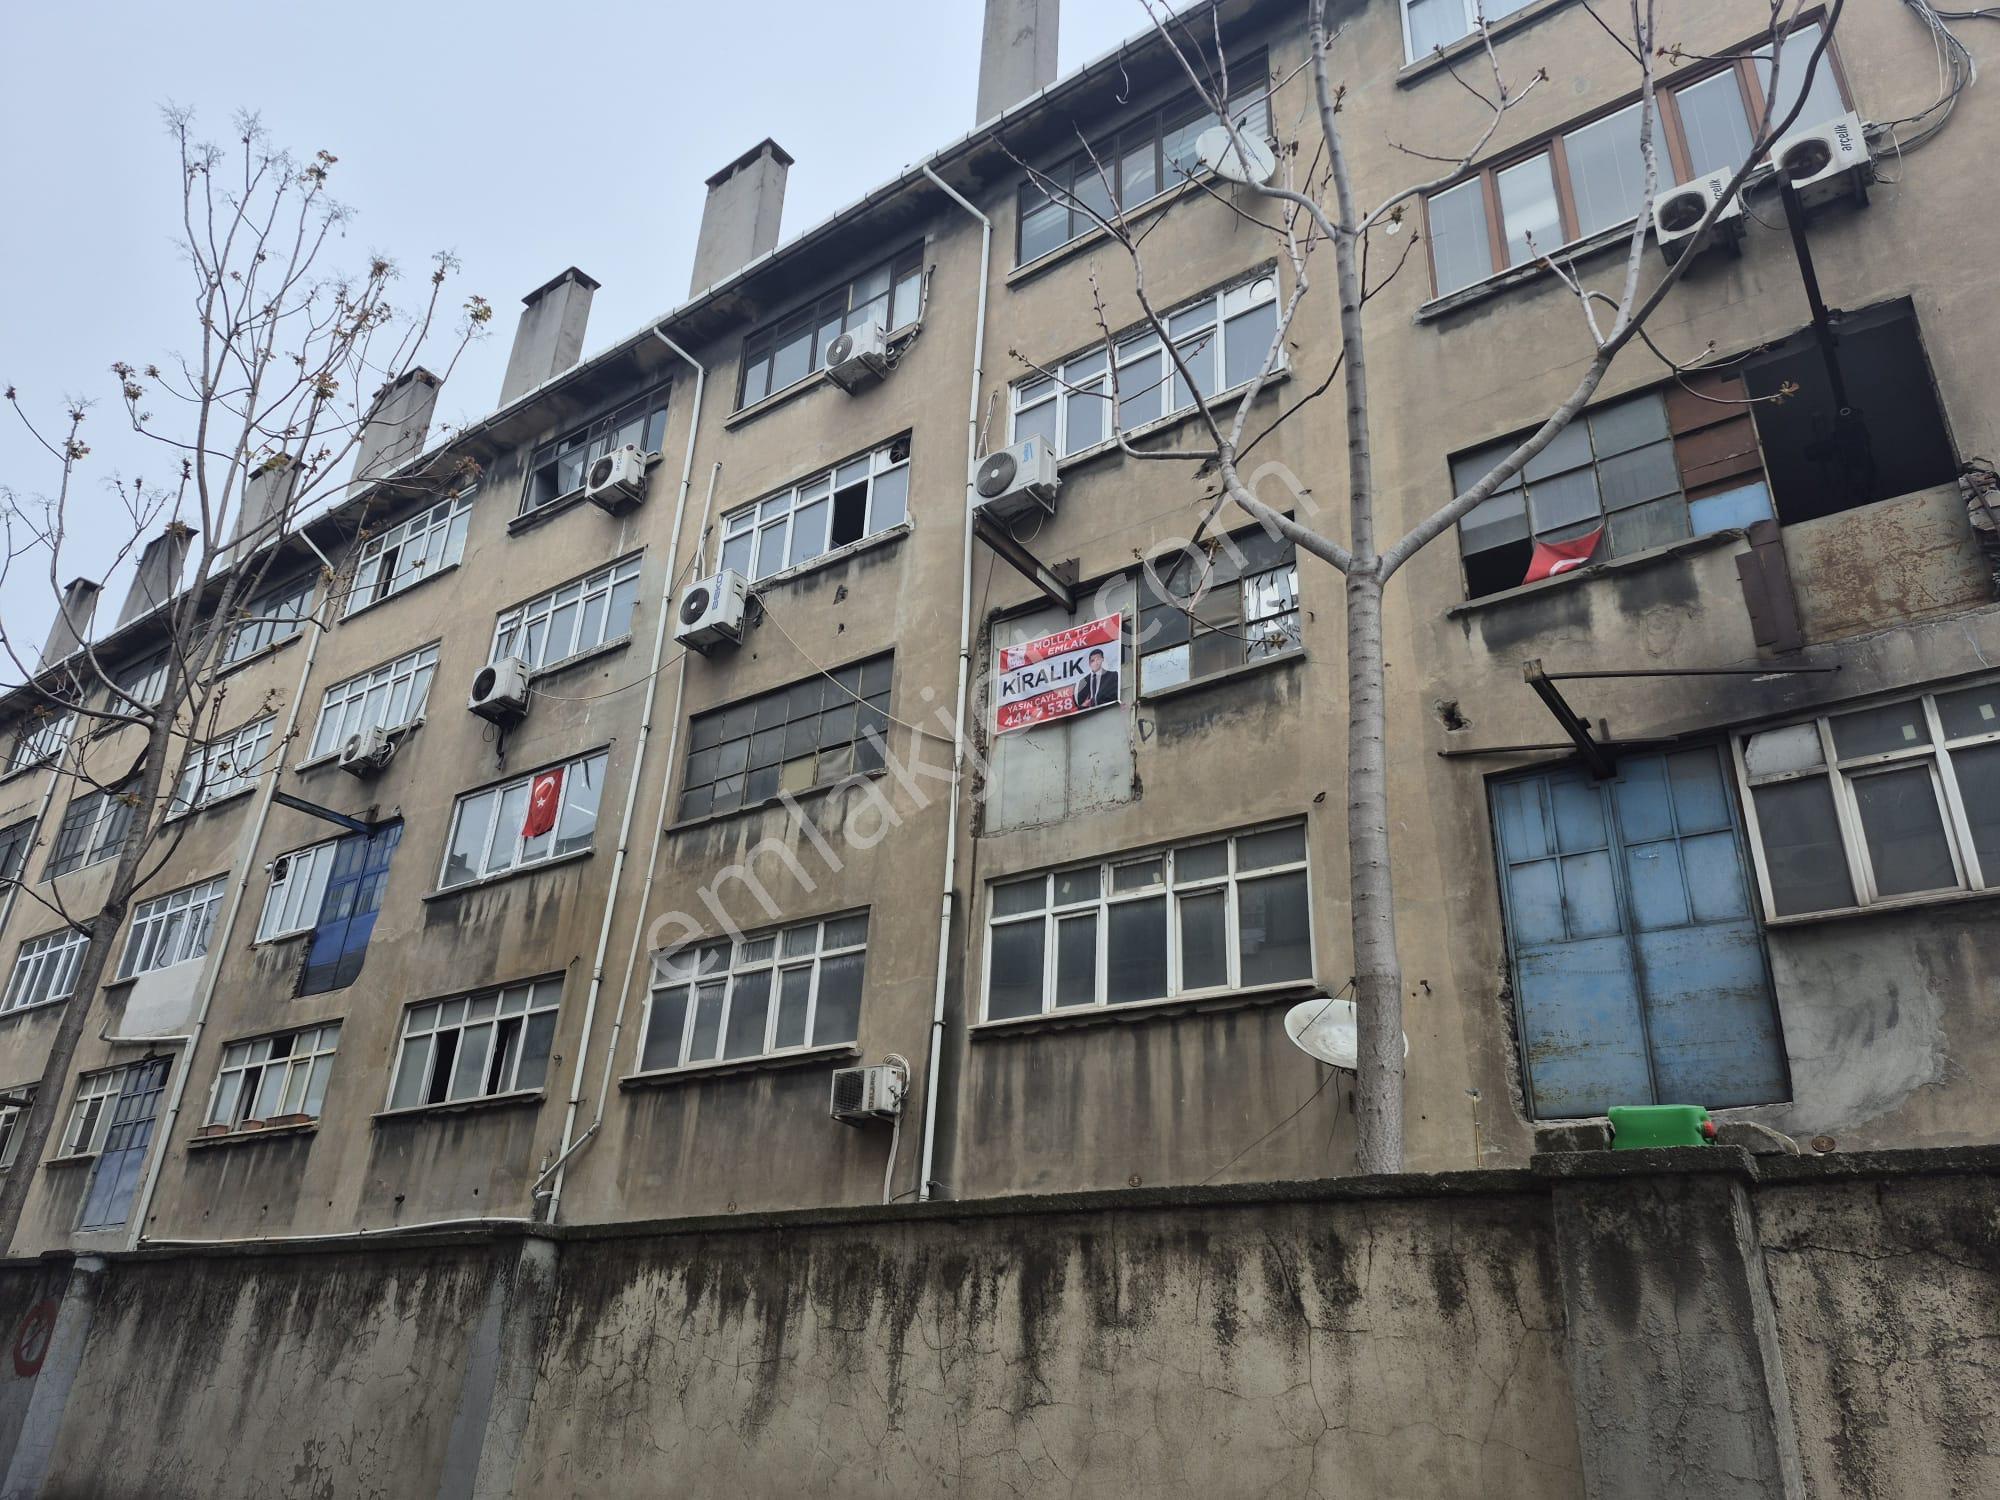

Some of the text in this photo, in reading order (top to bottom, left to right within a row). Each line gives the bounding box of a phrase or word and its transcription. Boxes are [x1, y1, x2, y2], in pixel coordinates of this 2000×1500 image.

[1833, 123, 1854, 152] arçelik
[1709, 178, 1725, 201] rçelik
[711, 573, 724, 611] BEKO
[1033, 620, 1107, 651] MOLLA TEAM
[1047, 637, 1088, 656] EMLAK
[1002, 656, 1084, 698] KİRALIK
[1004, 697, 1073, 727] 444 7 538
